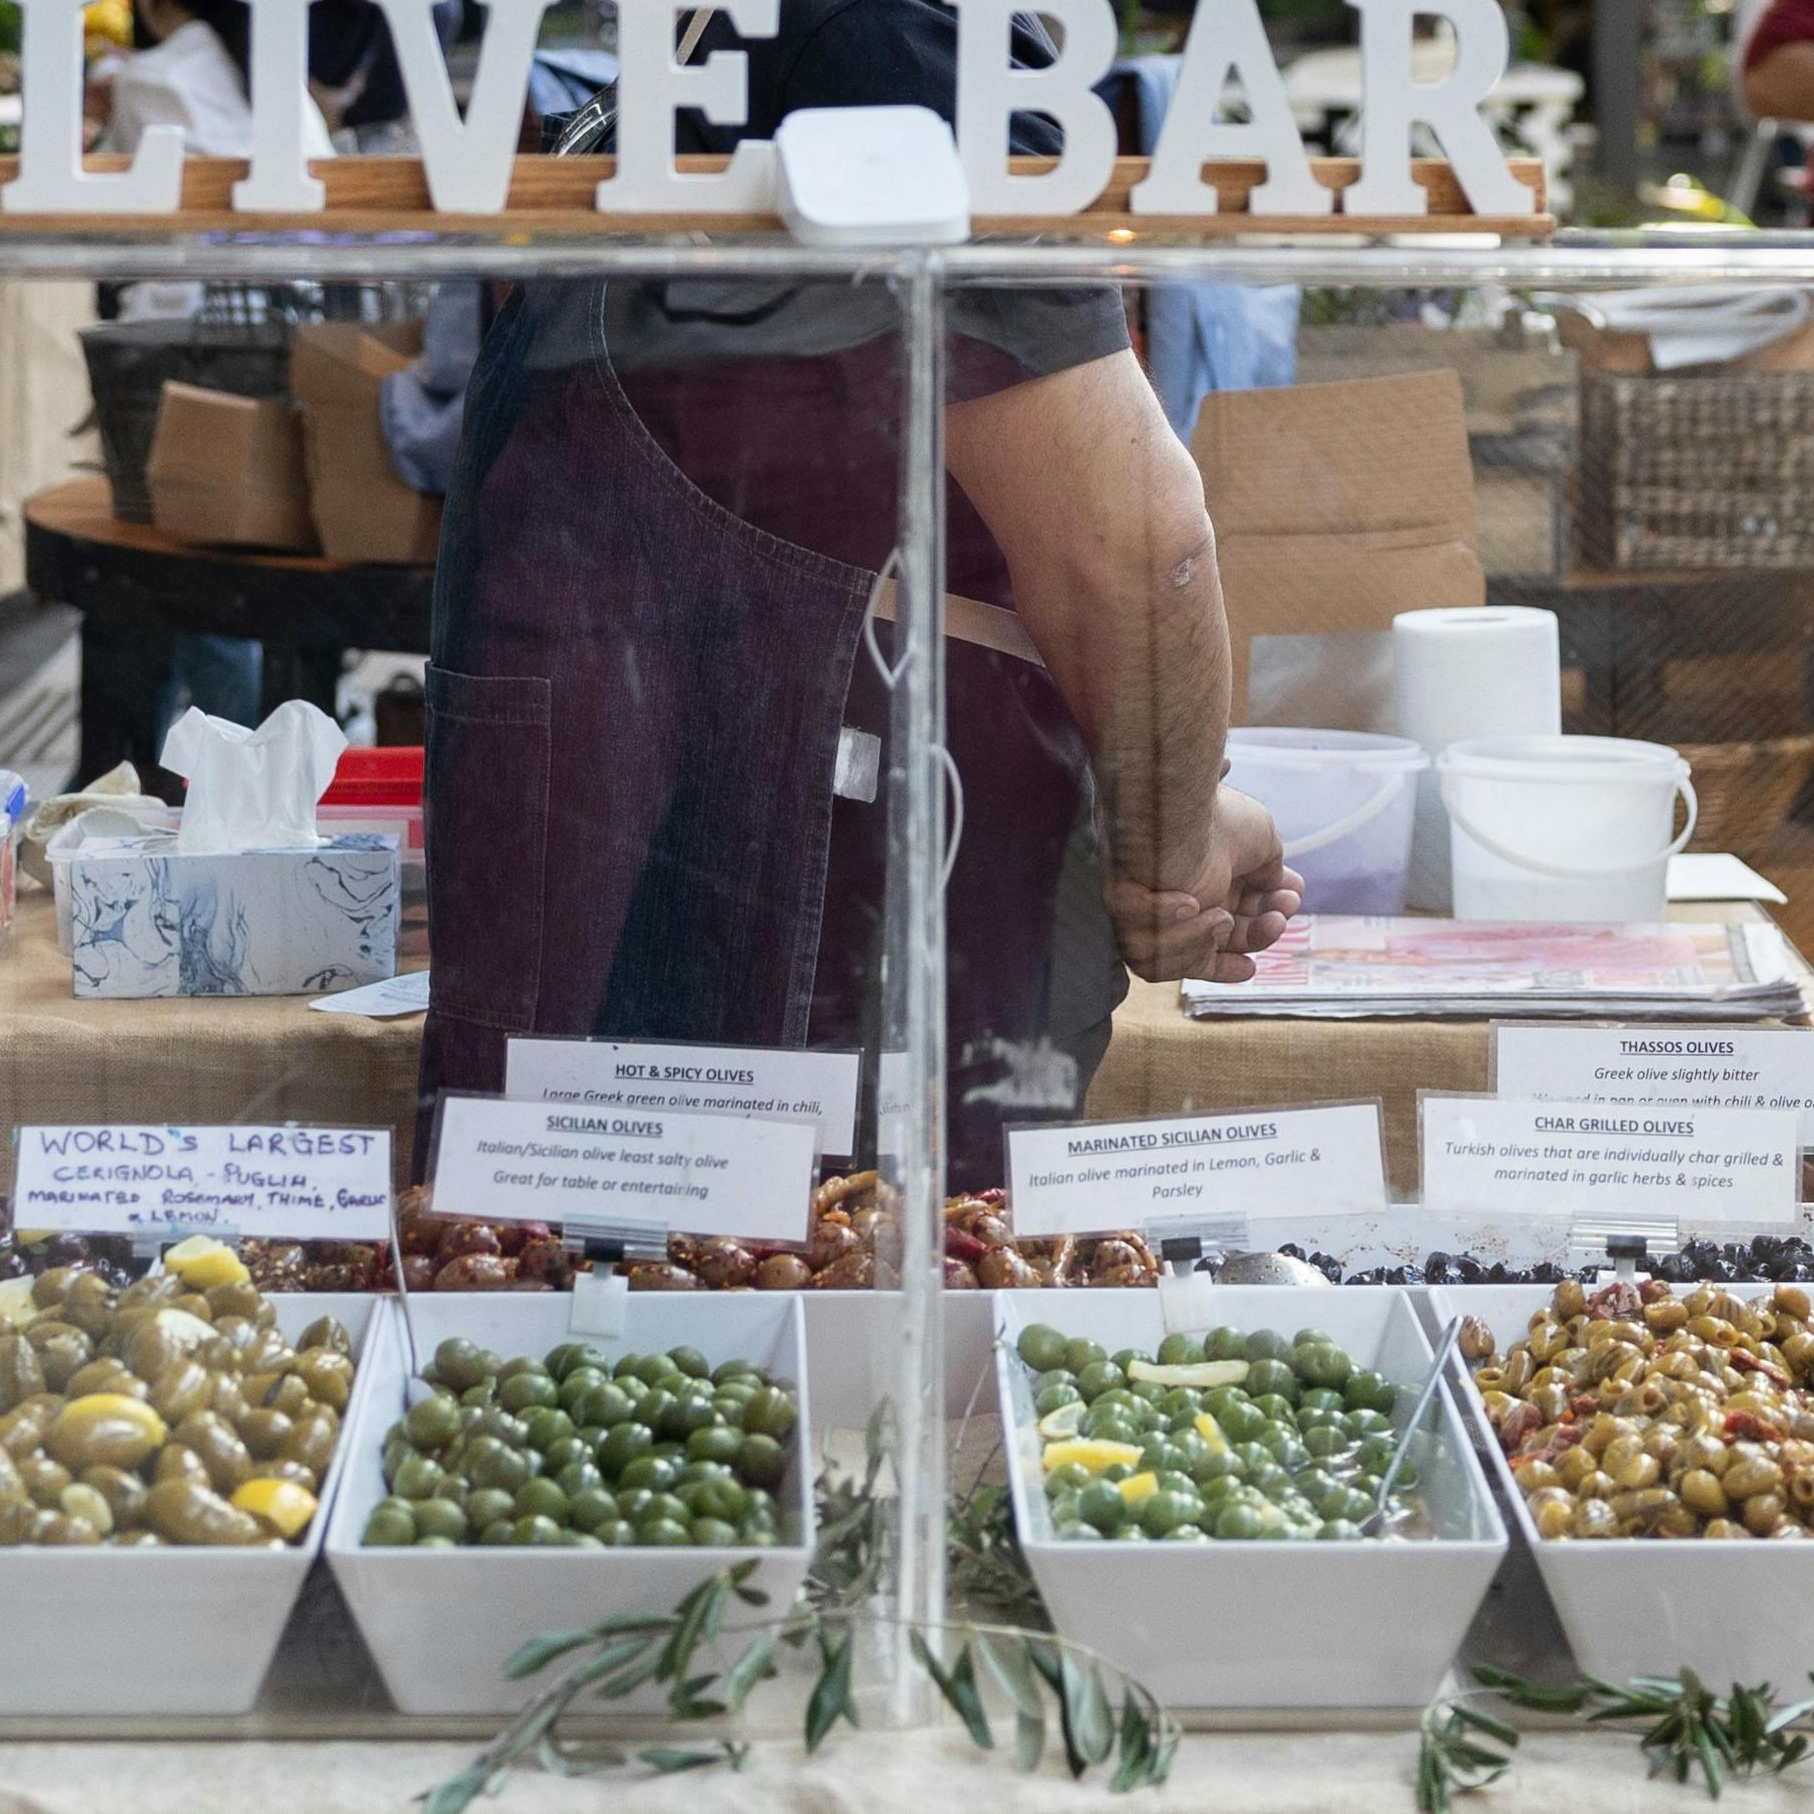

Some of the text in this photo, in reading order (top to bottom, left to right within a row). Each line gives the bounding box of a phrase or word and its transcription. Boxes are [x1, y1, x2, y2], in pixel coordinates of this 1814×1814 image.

[1620, 1040, 1734, 1055] THASSOS OLIVES
[614, 1063, 755, 1084] HOT & SPICY OLIVES
[1594, 1066, 1760, 1085] Greek olive slightly bitter
[584, 1089, 823, 1115] Greek olive marinated in chili,
[1724, 1096, 1751, 1109] chili
[1769, 1096, 1801, 1110] olive
[546, 1115, 663, 1136] SICILIAN OLIVES
[1534, 1116, 1694, 1136] CHAR GRILLED OLIVES
[229, 1132, 376, 1155] LARGEST
[1068, 1122, 1278, 1156] MARINATED SICILIAN OLIVES
[477, 1140, 728, 1170] Italian/Sicilian olive least salty olive
[1445, 1141, 1784, 1168] Turkish olives that are individually char grilled &
[1029, 1147, 1321, 1187] Italian olive marinated in Lemon, Garlic &
[1494, 1166, 1733, 1190] marinated in garlic herbs & spices
[493, 1170, 708, 1200] Great for table entertaining
[1152, 1183, 1203, 1200] Parsley
